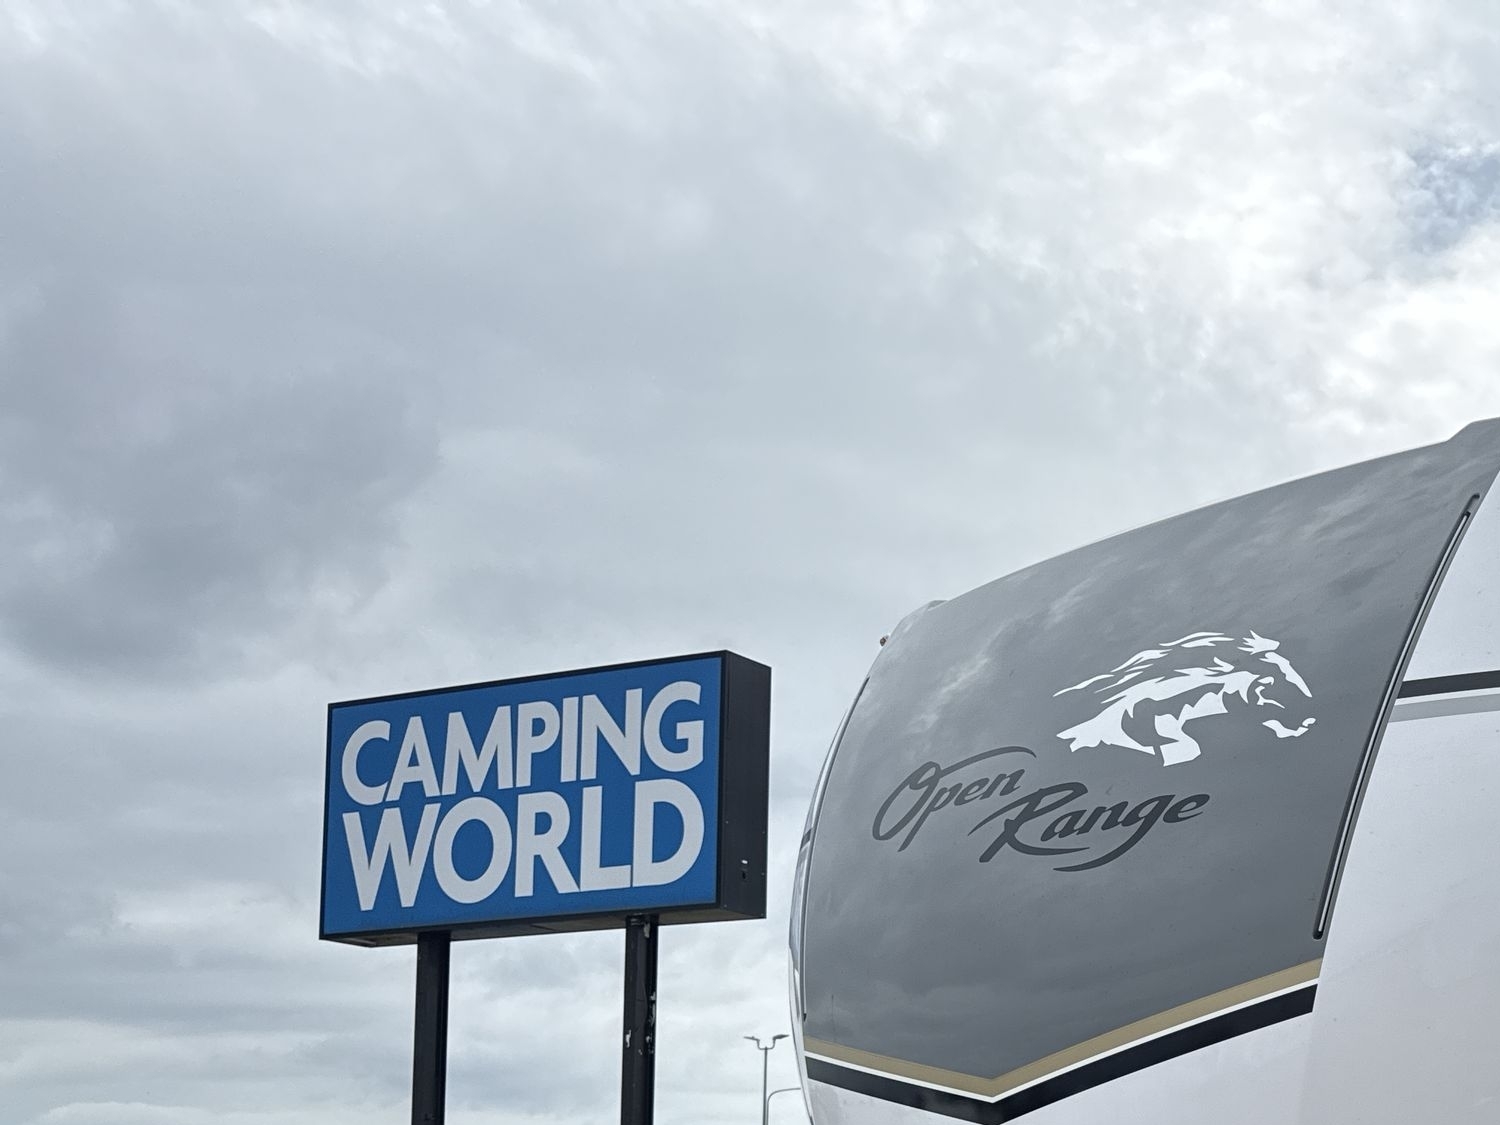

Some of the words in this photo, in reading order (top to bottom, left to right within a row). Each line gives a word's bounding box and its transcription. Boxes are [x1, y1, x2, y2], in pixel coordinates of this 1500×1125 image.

[341, 680, 705, 806] CAMPING
[872, 746, 1036, 852] Open
[342, 778, 705, 912] WORLD
[967, 781, 1211, 873] Range
